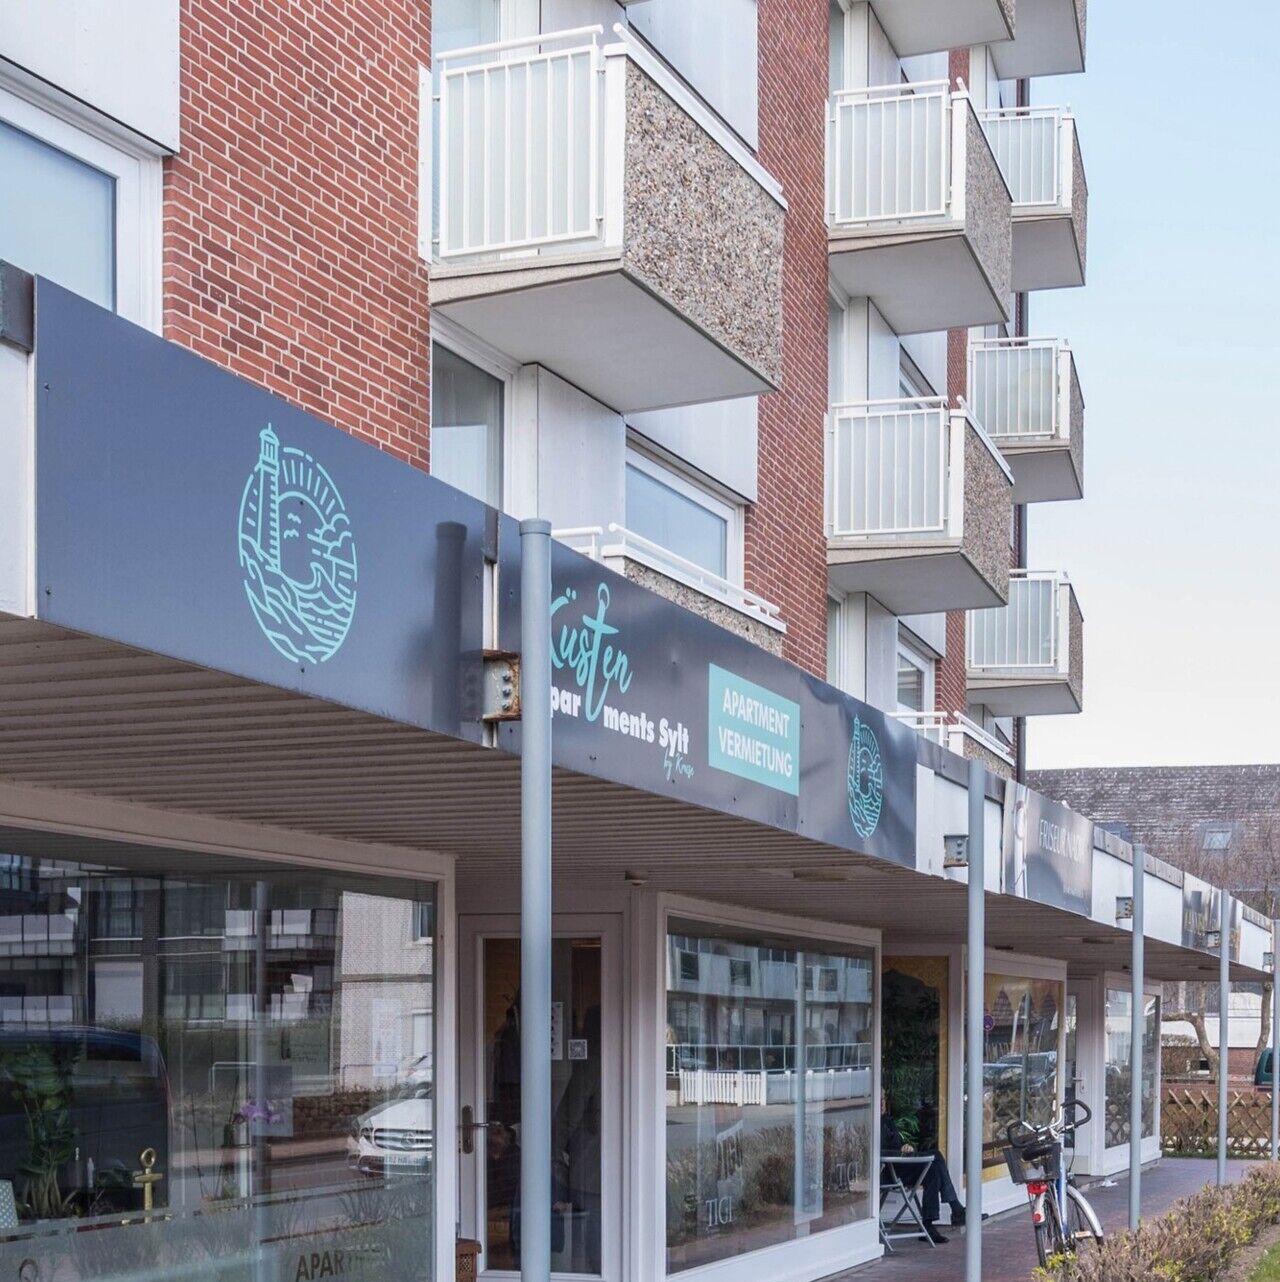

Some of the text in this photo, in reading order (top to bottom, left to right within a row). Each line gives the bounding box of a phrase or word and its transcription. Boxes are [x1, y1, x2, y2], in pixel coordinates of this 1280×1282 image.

[551, 685, 582, 718] par
[658, 717, 690, 757] Sylt
[722, 687, 791, 739] APARTMENT
[718, 726, 793, 778] VERMIETUNG
[1039, 818, 1066, 857] FRISEUR
[705, 1196, 733, 1227] TIGI
